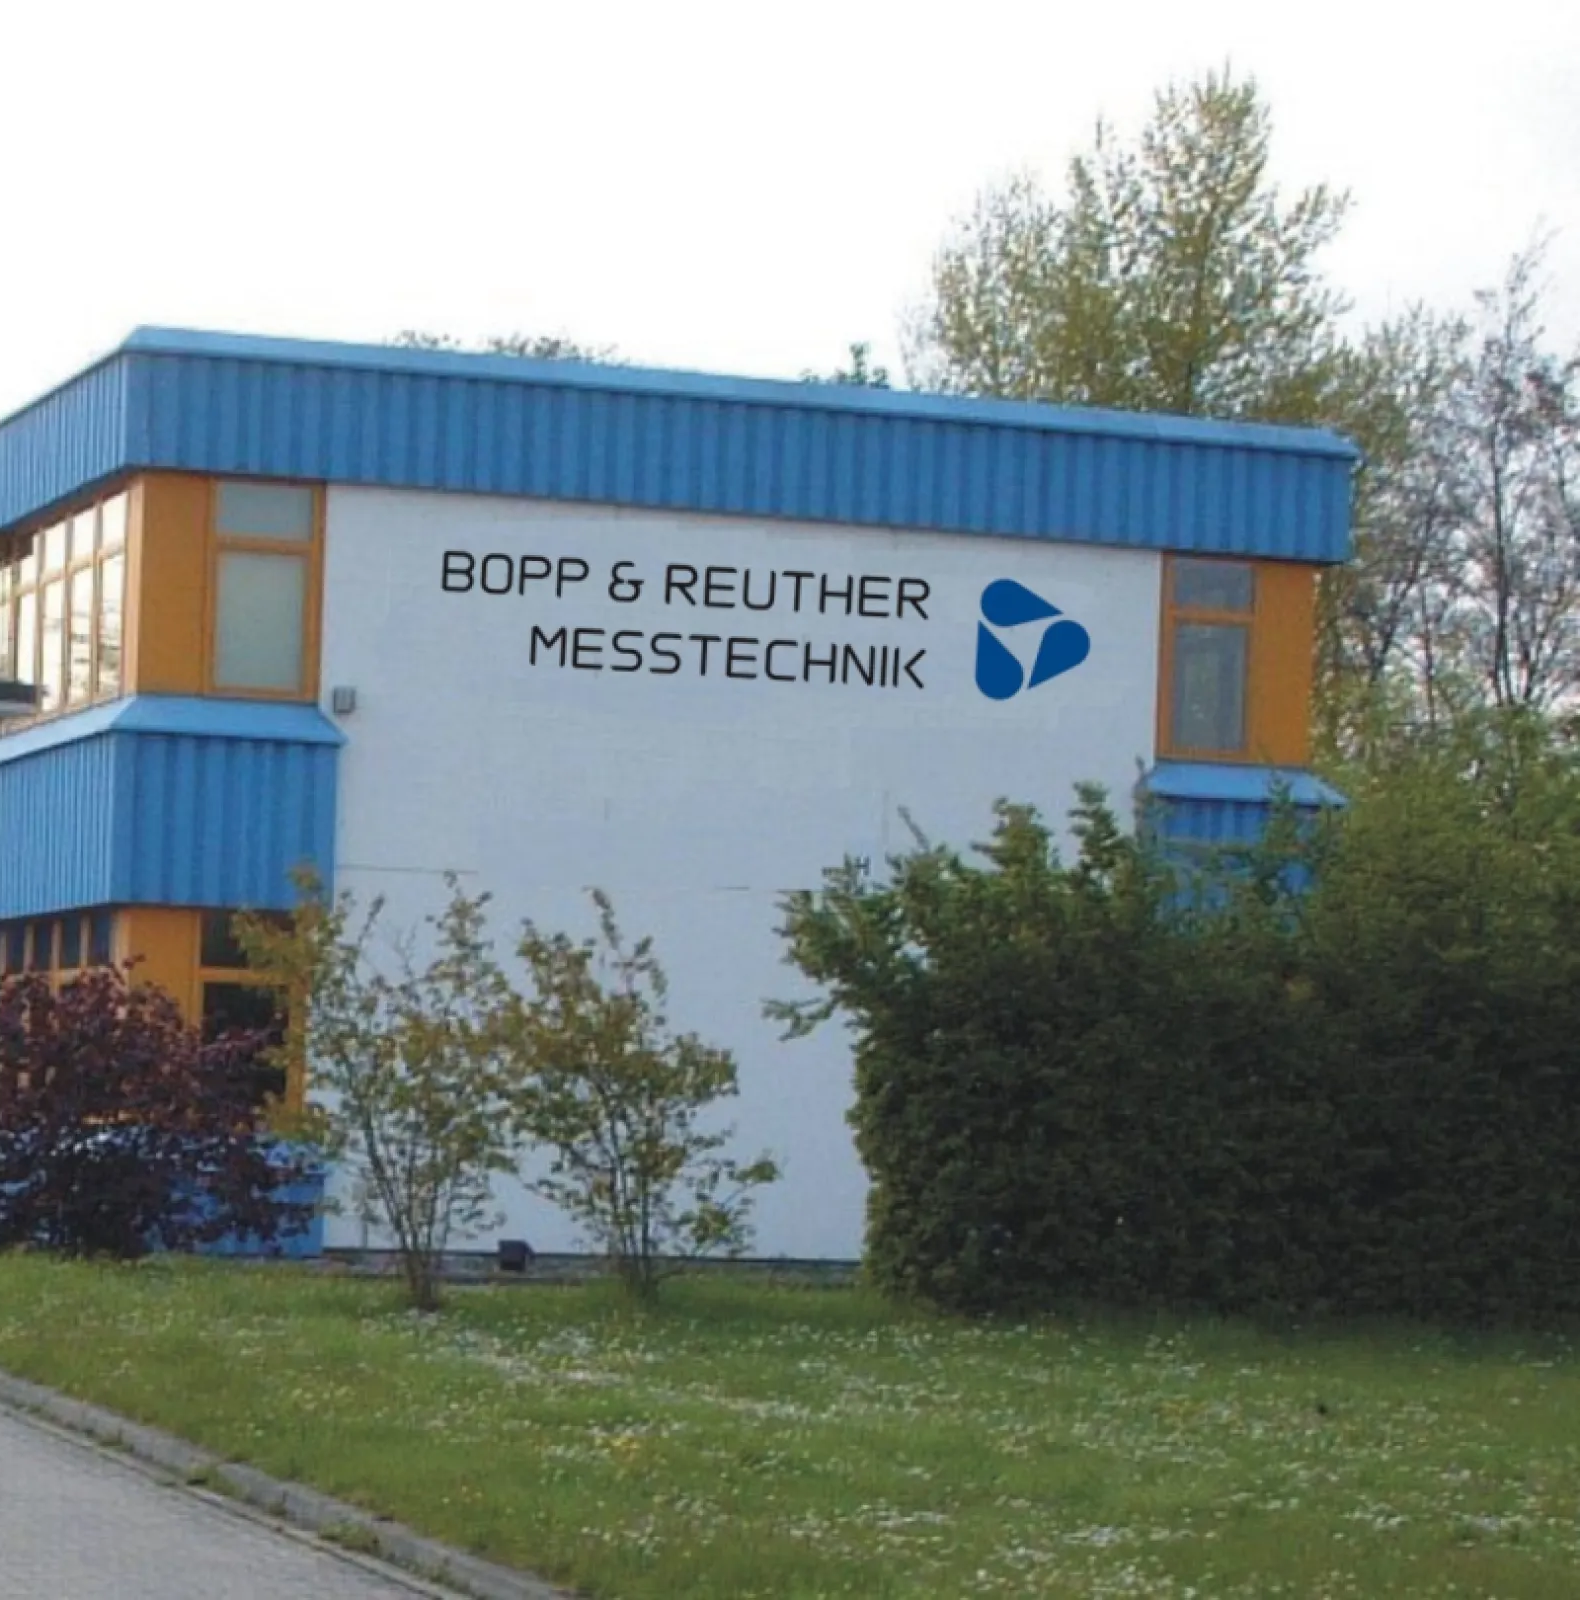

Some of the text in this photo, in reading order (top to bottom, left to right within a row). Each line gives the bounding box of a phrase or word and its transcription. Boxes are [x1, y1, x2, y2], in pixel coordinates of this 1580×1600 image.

[441, 549, 932, 620] BOPP & REUTHER
[529, 625, 928, 690] MESSTECHNIK
